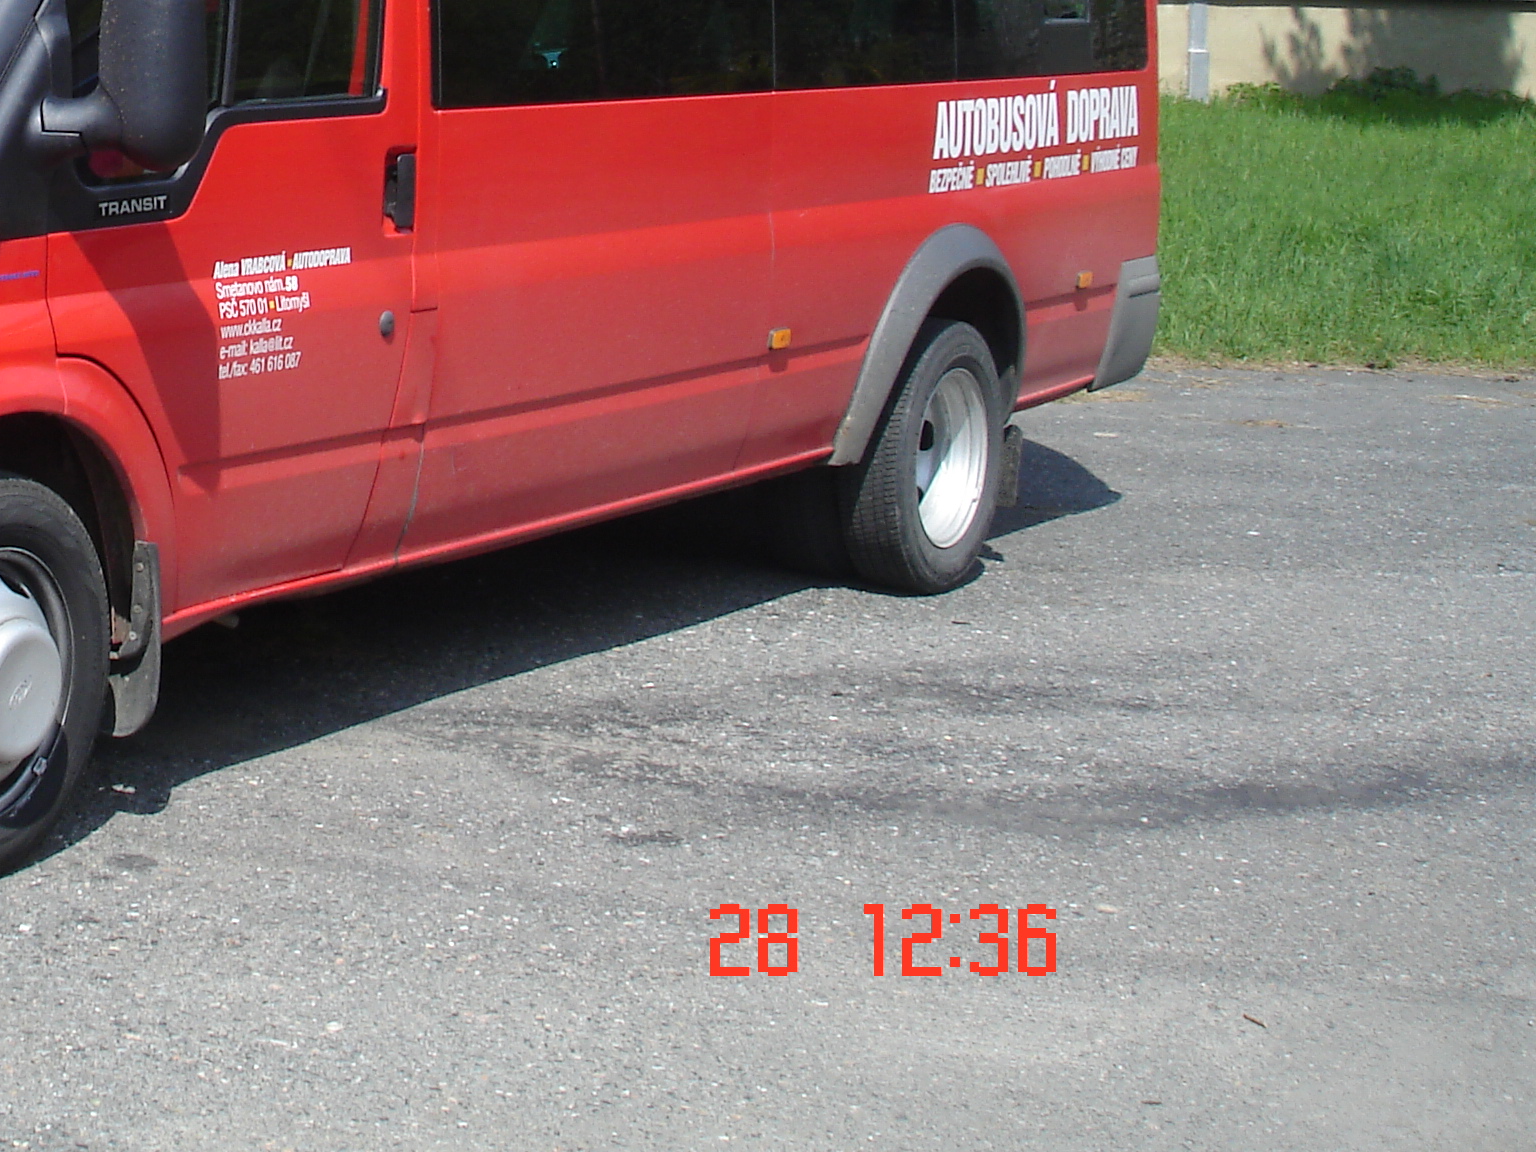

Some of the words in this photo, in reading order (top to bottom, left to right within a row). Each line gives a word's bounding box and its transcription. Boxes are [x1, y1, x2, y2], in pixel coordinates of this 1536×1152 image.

[932, 79, 1060, 160] AUTOBUSOVÁ
[1066, 85, 1139, 144] DOPRAVA
[98, 195, 167, 217] TRANSIT
[213, 261, 240, 279] Alena
[240, 250, 287, 276] VRABCOVÁ
[292, 247, 351, 269] AUTODOPRAVA
[215, 281, 264, 300] Smetanovo
[218, 298, 239, 320] PSČ
[239, 298, 257, 317] 570
[257, 297, 269, 315] 01
[274, 291, 311, 313] Litomyšl
[249, 356, 266, 375] 461
[266, 354, 284, 372] 616
[284, 351, 302, 369] 087
